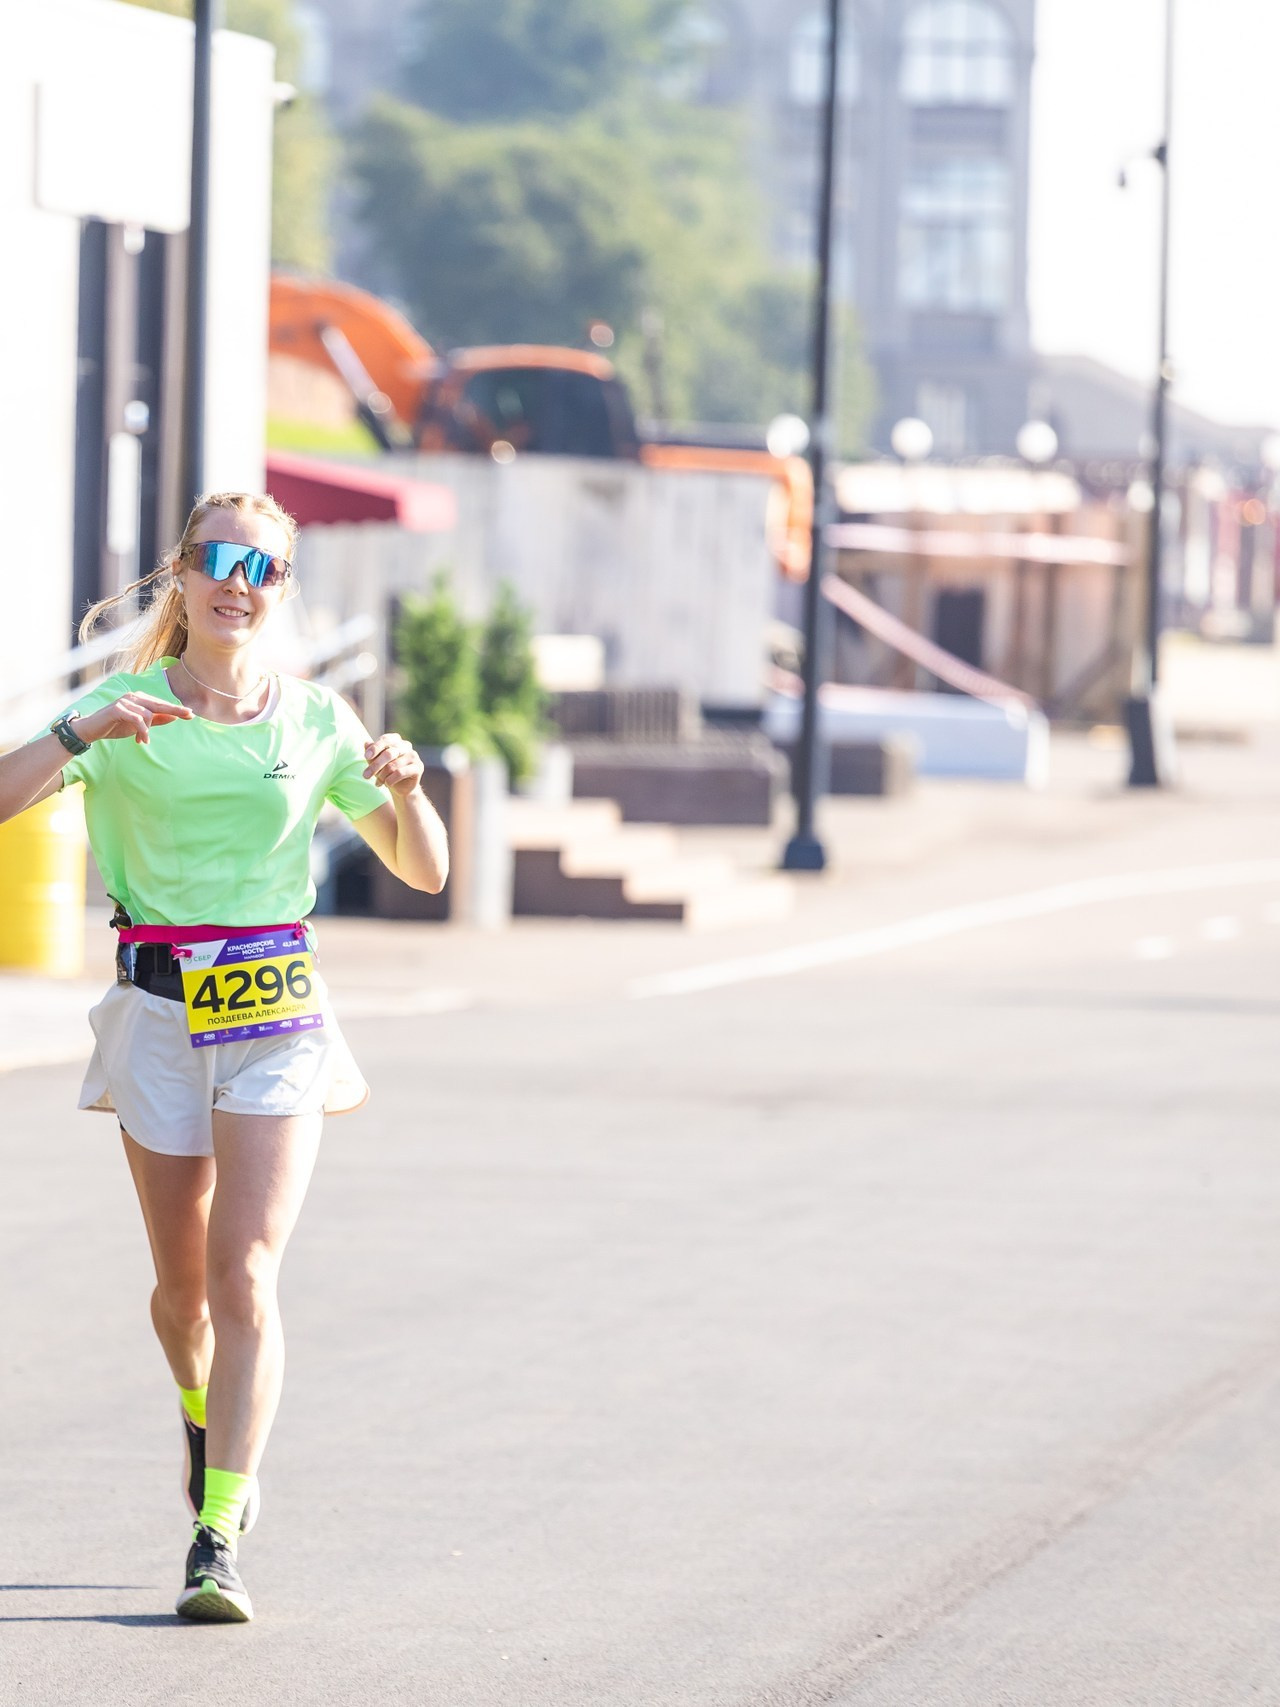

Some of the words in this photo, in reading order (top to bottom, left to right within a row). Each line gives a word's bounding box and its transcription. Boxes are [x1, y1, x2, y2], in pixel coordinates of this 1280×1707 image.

[227, 939, 275, 952] КРАСНОЯРСКИЕ
[242, 947, 265, 955] МОСТЫ
[193, 954, 212, 962] СБЕР
[191, 960, 312, 1014] 4296
[207, 1012, 253, 1026] ПОЗДЕЕВА
[255, 1003, 307, 1018] АЛЕКСАНДРА
